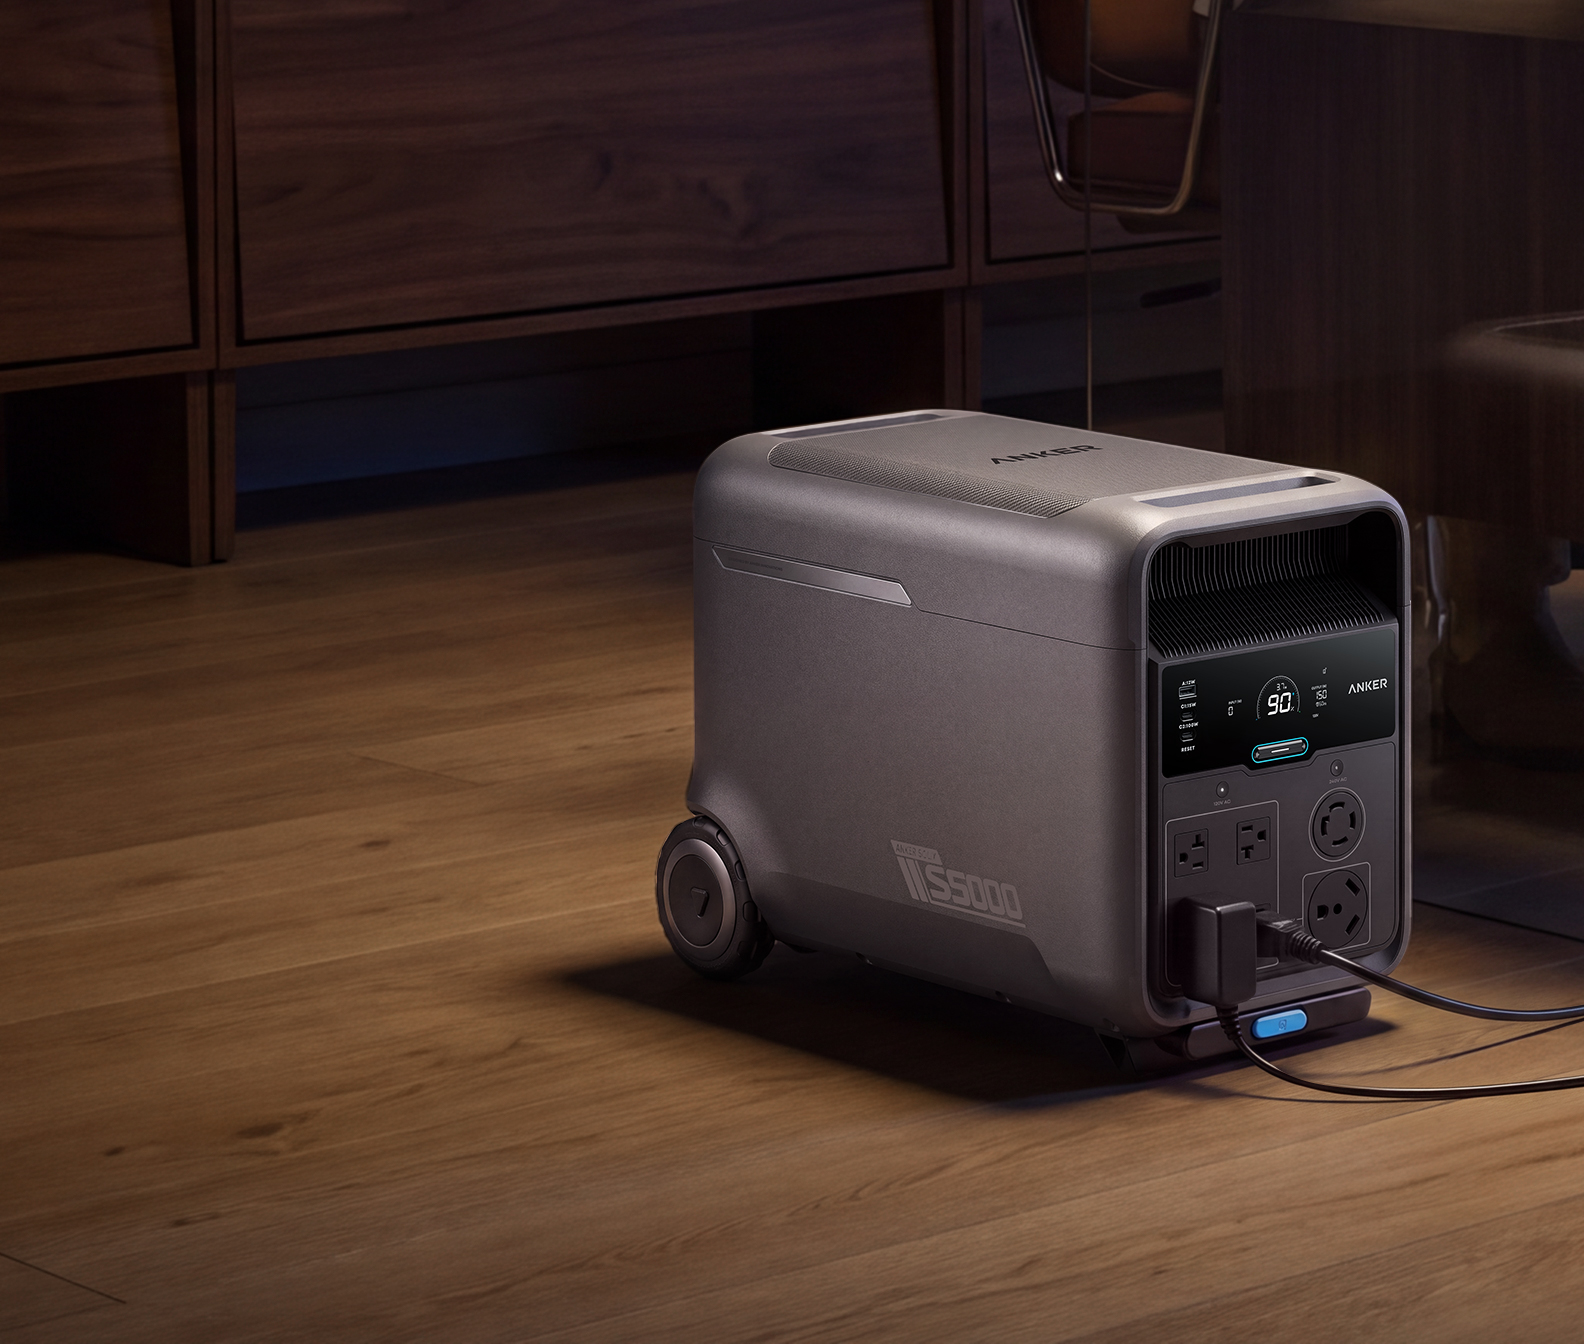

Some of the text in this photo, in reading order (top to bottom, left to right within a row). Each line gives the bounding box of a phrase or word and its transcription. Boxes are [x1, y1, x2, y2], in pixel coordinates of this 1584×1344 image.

[990, 444, 1104, 465] ANKER
[1347, 677, 1388, 695] ANKER
[1180, 745, 1196, 753] RESET
[896, 843, 917, 857] ANKER
[925, 864, 1023, 920] S5000
